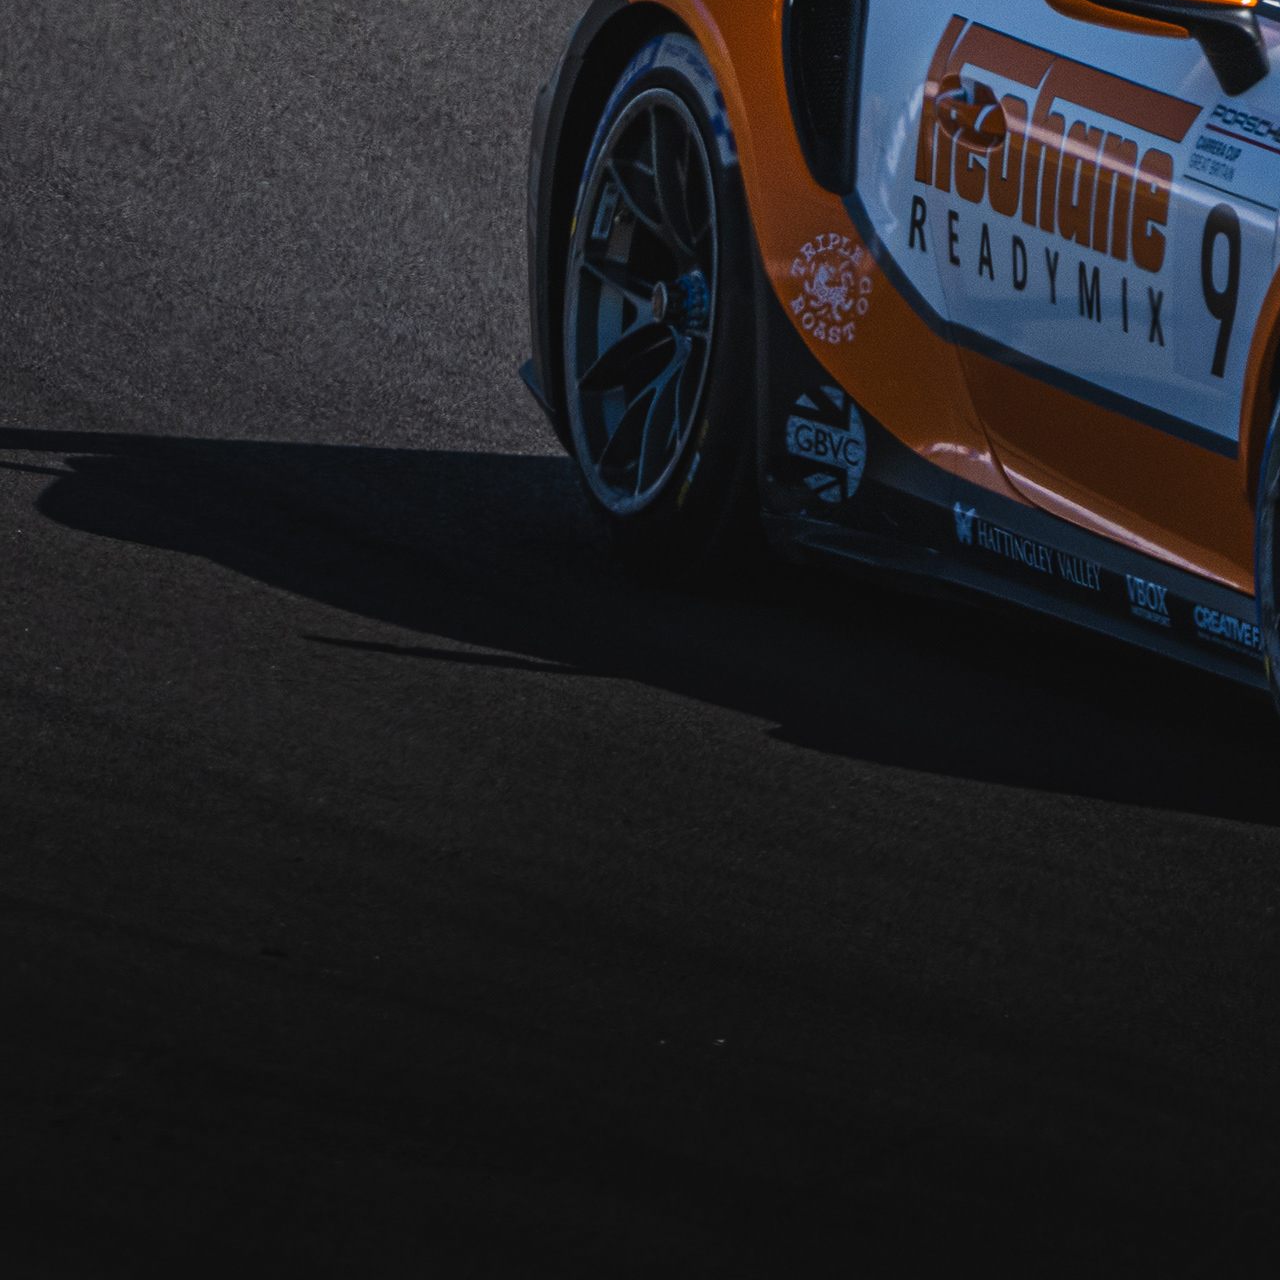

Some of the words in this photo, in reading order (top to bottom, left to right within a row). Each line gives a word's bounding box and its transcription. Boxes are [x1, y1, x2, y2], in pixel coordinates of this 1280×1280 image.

[908, 194, 1165, 348] READYMIX
[1200, 202, 1242, 379] 9
[790, 294, 856, 345] ROAST
[794, 423, 859, 466] GBVC
[976, 518, 1056, 575] HATTINGLEY
[1056, 550, 1102, 591] VALLEY
[1125, 573, 1169, 616] VBOX
